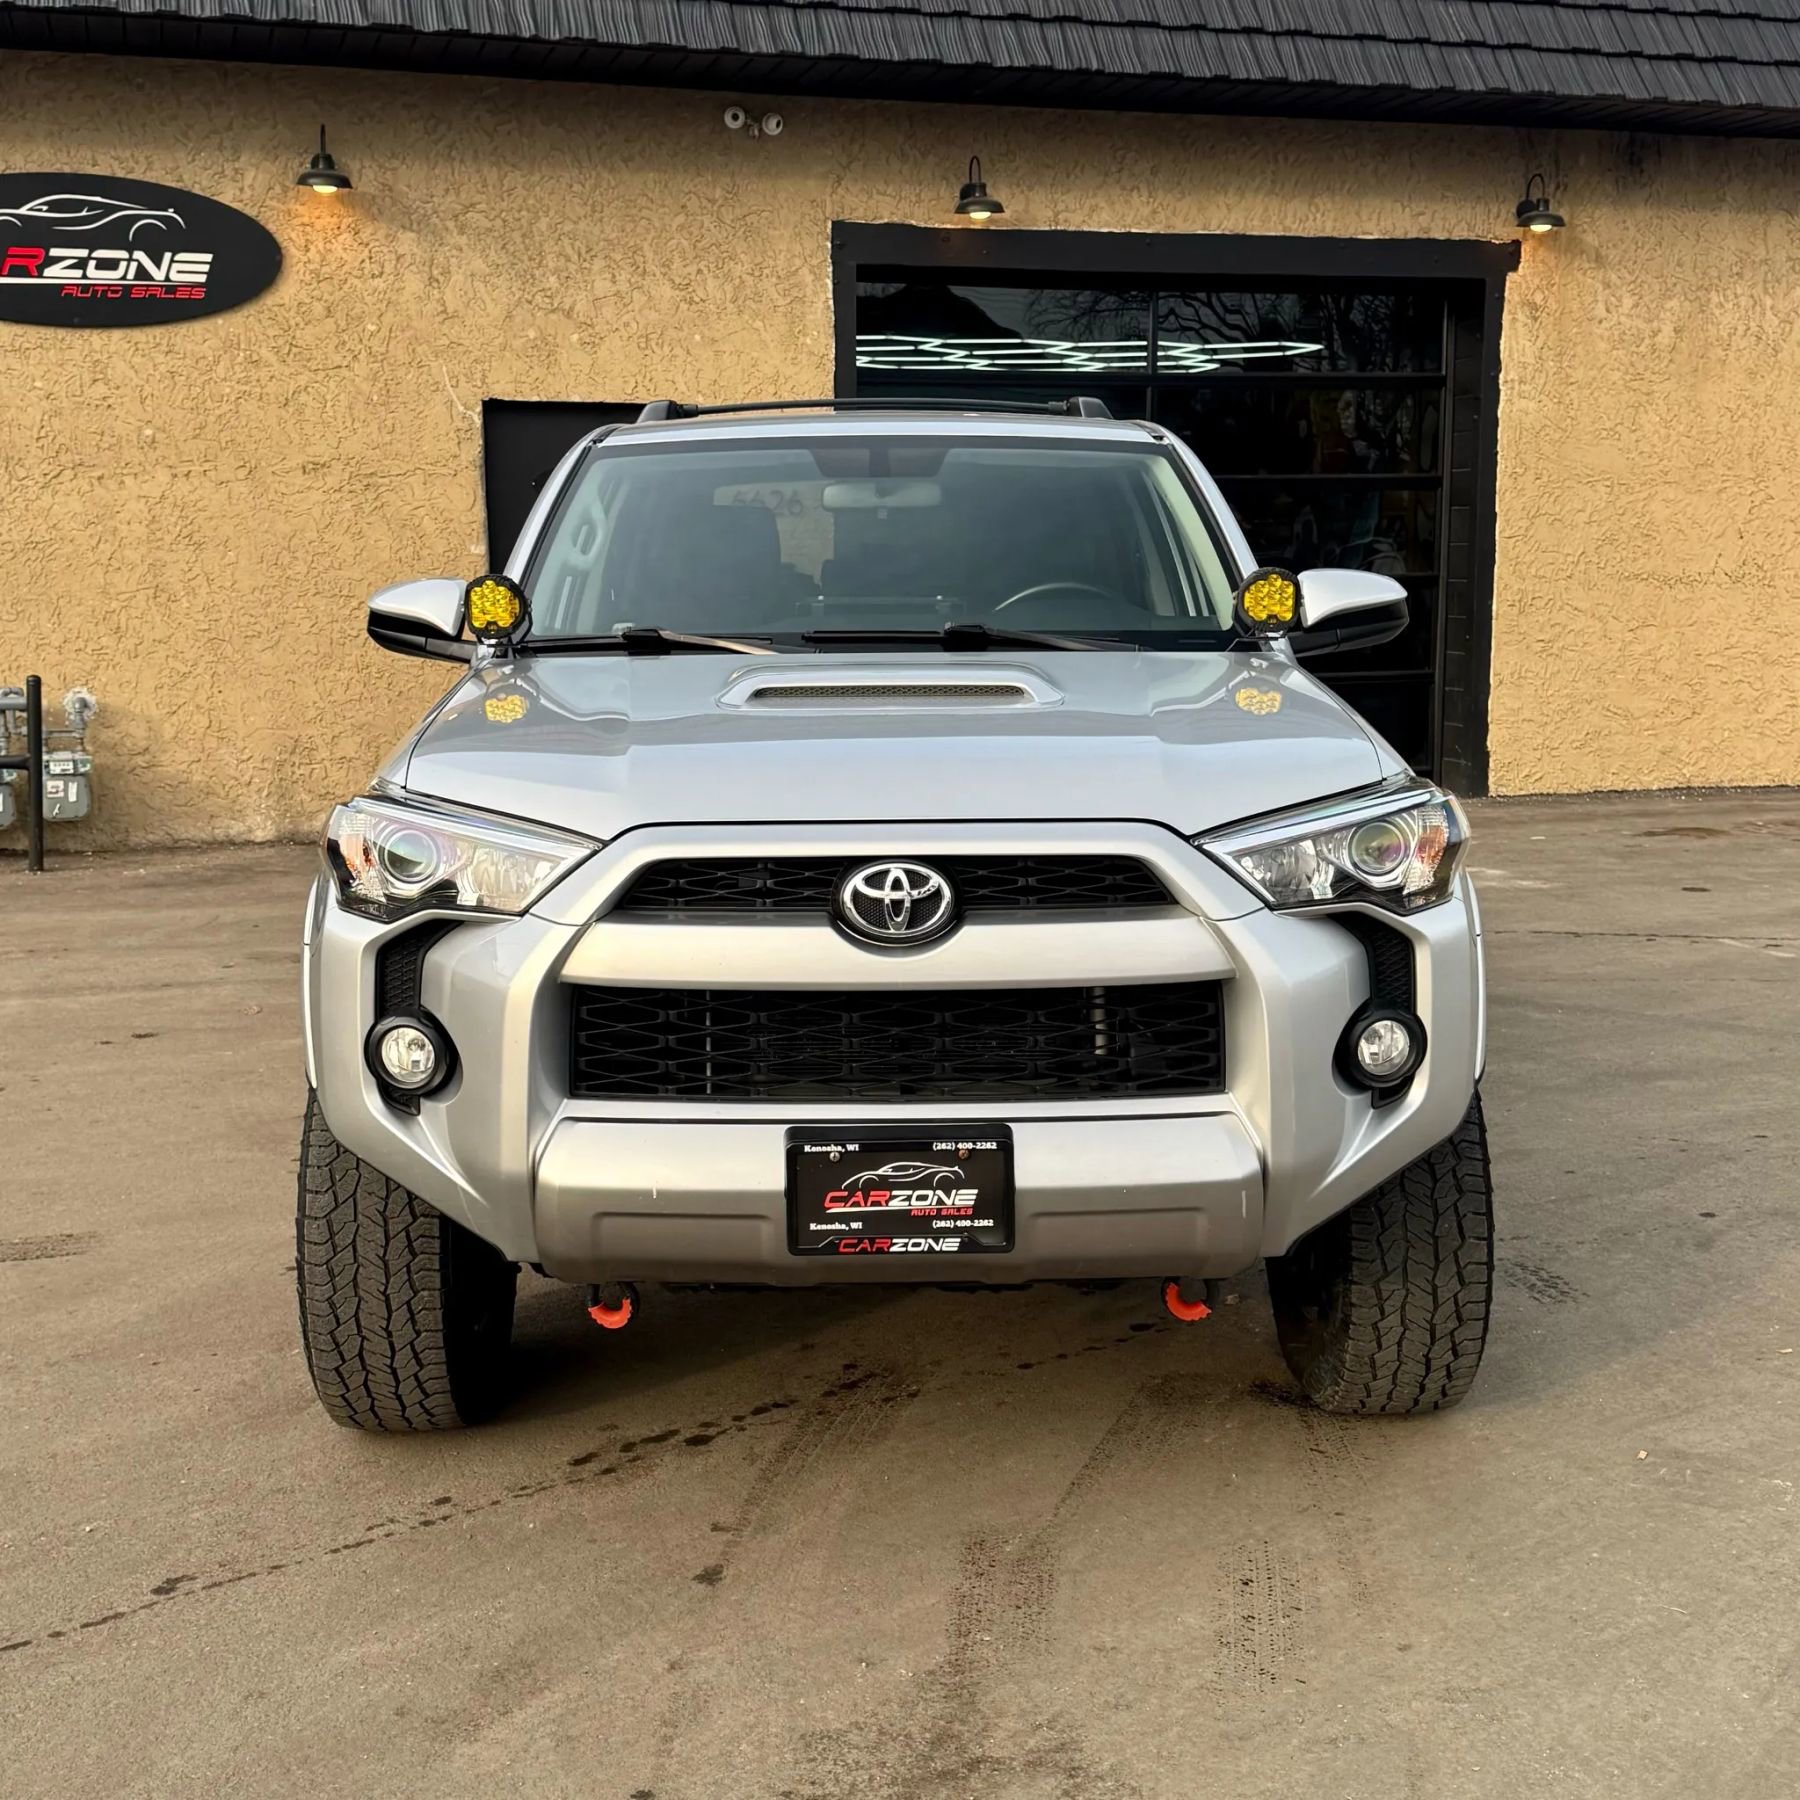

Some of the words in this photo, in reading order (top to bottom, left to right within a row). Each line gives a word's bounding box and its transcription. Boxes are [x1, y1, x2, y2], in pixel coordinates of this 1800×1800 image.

[61, 285, 123, 298] AUTO
[130, 286, 207, 300] SALES
[804, 1143, 845, 1153] Kenosha,
[846, 1143, 860, 1152] WI
[823, 1188, 979, 1208] CARZONE
[911, 1208, 937, 1217] AUTO
[941, 1207, 974, 1216] SALES
[809, 1221, 849, 1231] Kenosha,
[850, 1221, 863, 1230] WI
[838, 1237, 962, 1253] CARZONE
